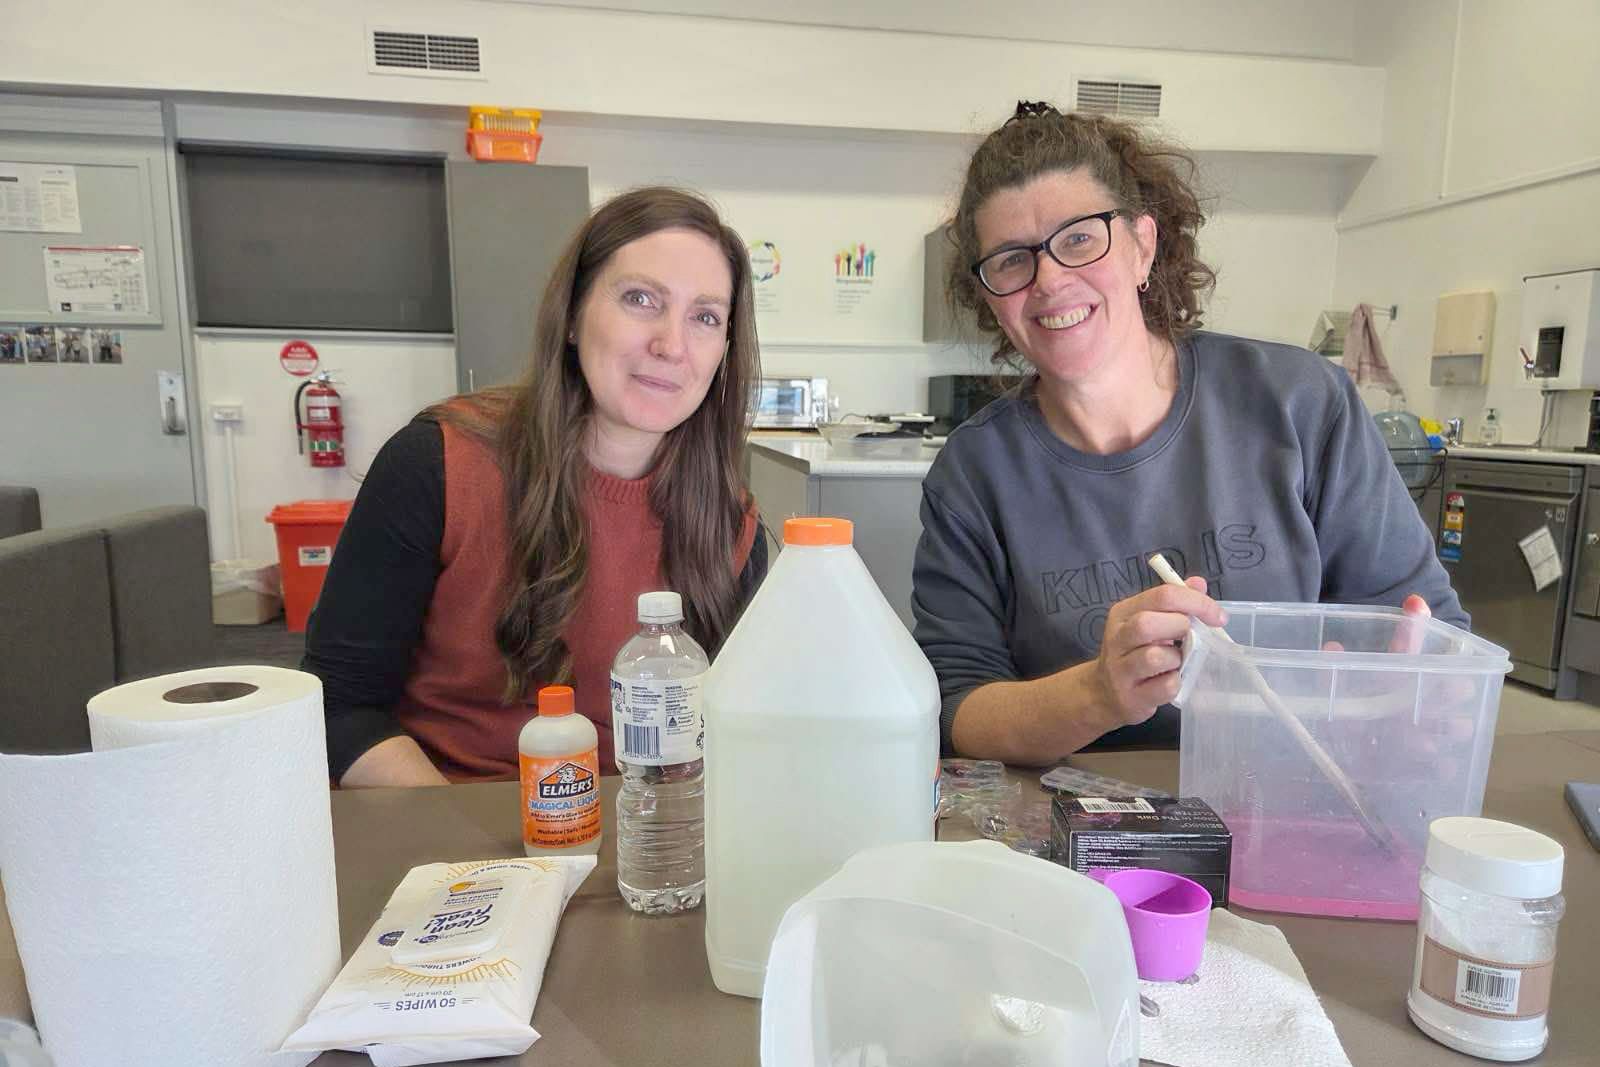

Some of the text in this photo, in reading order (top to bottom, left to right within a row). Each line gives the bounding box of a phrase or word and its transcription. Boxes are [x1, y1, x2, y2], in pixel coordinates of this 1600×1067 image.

[1202, 523, 1265, 577] IS
[542, 777, 592, 796] ELMER'S
[531, 799, 574, 810] MAGICAL
[423, 903, 493, 930] freak!
[429, 914, 491, 934] Clean
[395, 997, 457, 1012] 50 WIPES
